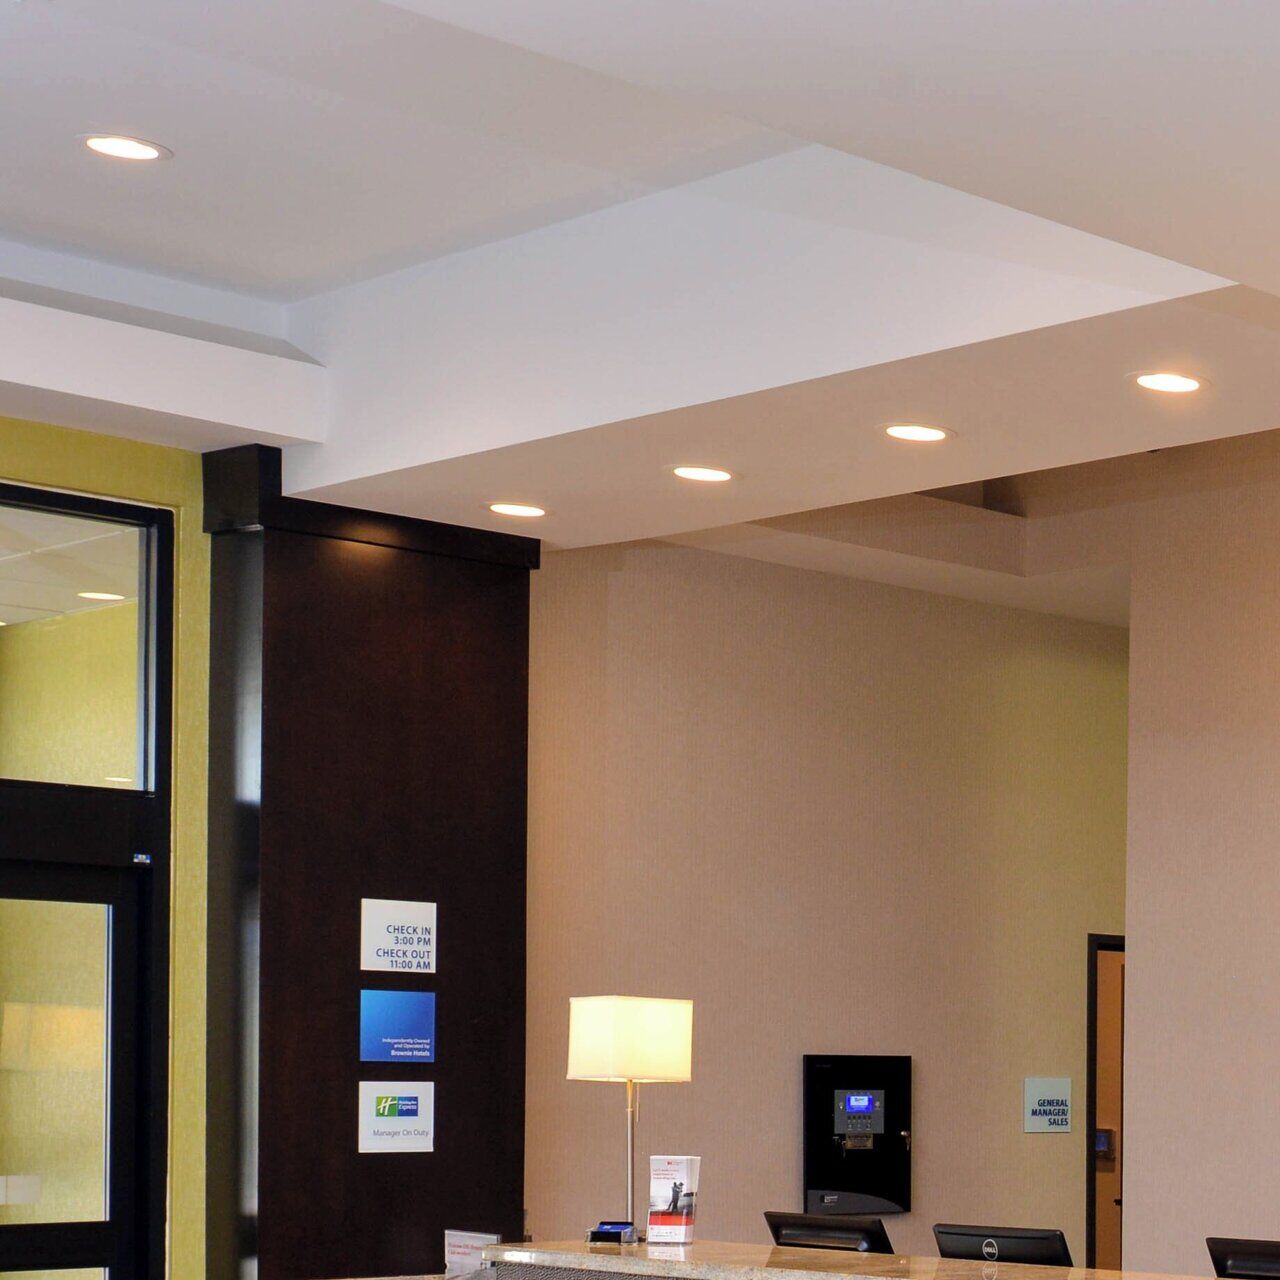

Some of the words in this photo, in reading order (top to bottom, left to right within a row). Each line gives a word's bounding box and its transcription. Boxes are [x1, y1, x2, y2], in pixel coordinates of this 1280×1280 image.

[386, 924, 419, 935] CHECK
[421, 926, 431, 936] IN
[394, 936, 414, 946] 3:00
[417, 936, 431, 946] PM
[376, 948, 408, 958] CHECK
[411, 949, 431, 960] OUT
[390, 960, 413, 969] 11:00
[416, 960, 431, 970] AM
[1037, 1098, 1069, 1107] GENERAL
[1031, 1108, 1069, 1117] MANAGER/
[1048, 1117, 1069, 1126] SALES
[373, 1129, 401, 1138] Manager
[402, 1129, 413, 1137] On
[413, 1129, 429, 1138] Duty
